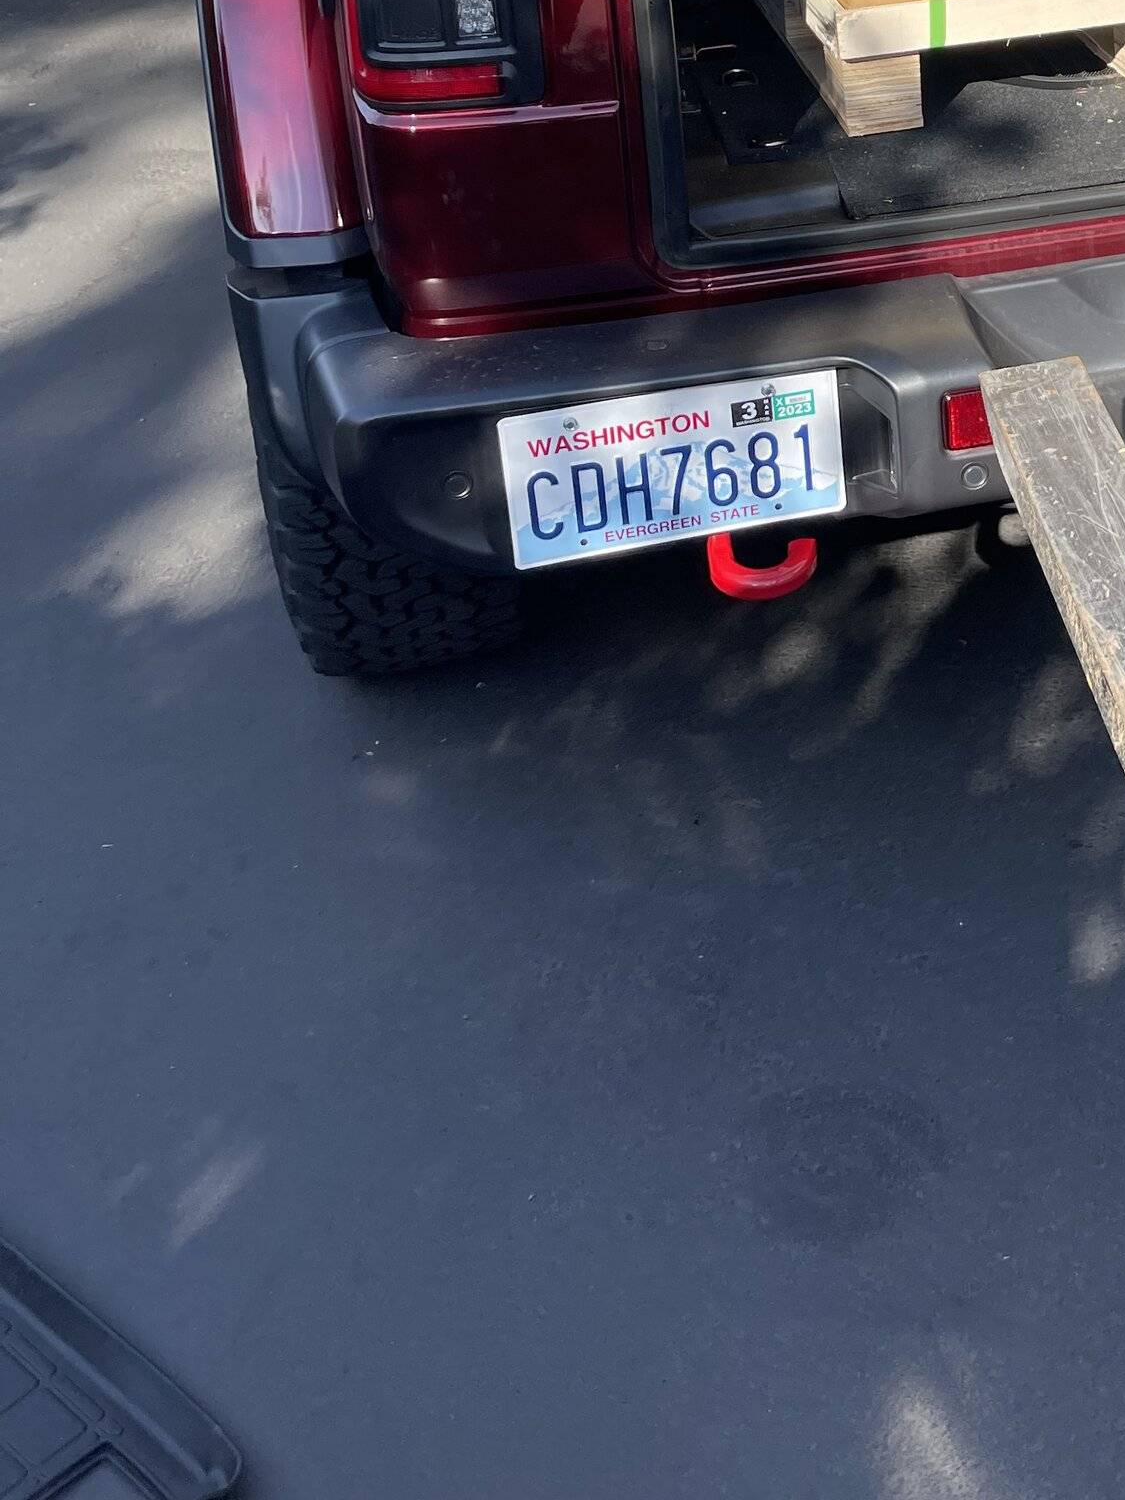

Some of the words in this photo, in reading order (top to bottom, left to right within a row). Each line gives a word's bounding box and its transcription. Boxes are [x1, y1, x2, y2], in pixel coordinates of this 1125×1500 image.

[741, 402, 758, 420] 3
[775, 397, 784, 407] X
[778, 402, 812, 417] 2023
[527, 410, 711, 458] WASHINGTON
[527, 424, 815, 540] CDH7681
[605, 515, 702, 543] EVERGREEN
[710, 504, 760, 523] STATE
